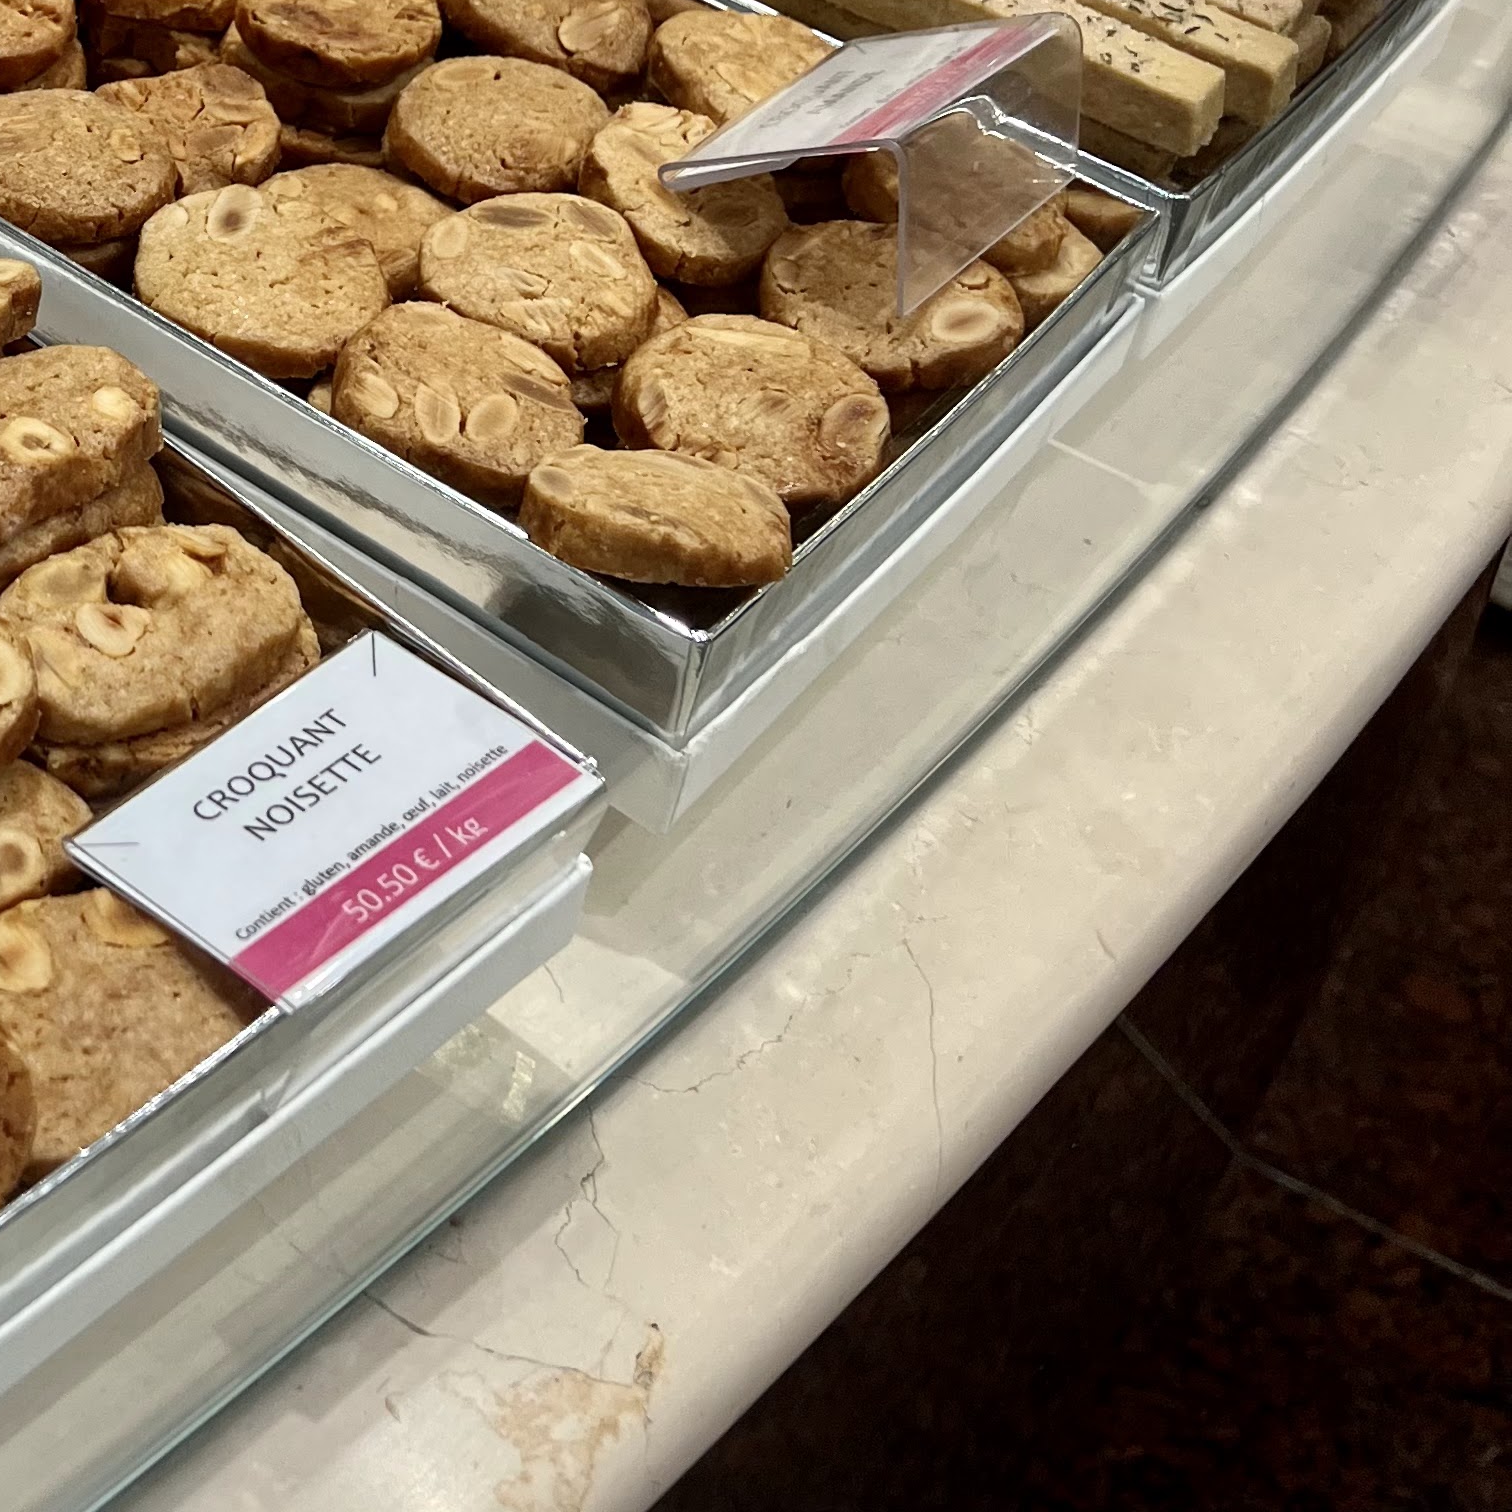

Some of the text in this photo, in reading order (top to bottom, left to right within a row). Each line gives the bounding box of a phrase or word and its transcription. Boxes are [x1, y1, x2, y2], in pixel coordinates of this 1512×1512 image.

[193, 708, 347, 820] CROQUANT
[243, 743, 382, 841] NOISETTE
[235, 896, 293, 940] Contient
[301, 861, 351, 896] gluten,
[346, 821, 406, 861] amande,
[429, 781, 461, 801] lait,
[457, 744, 509, 784] noisette
[341, 817, 489, 924] 50.50 € / kg
